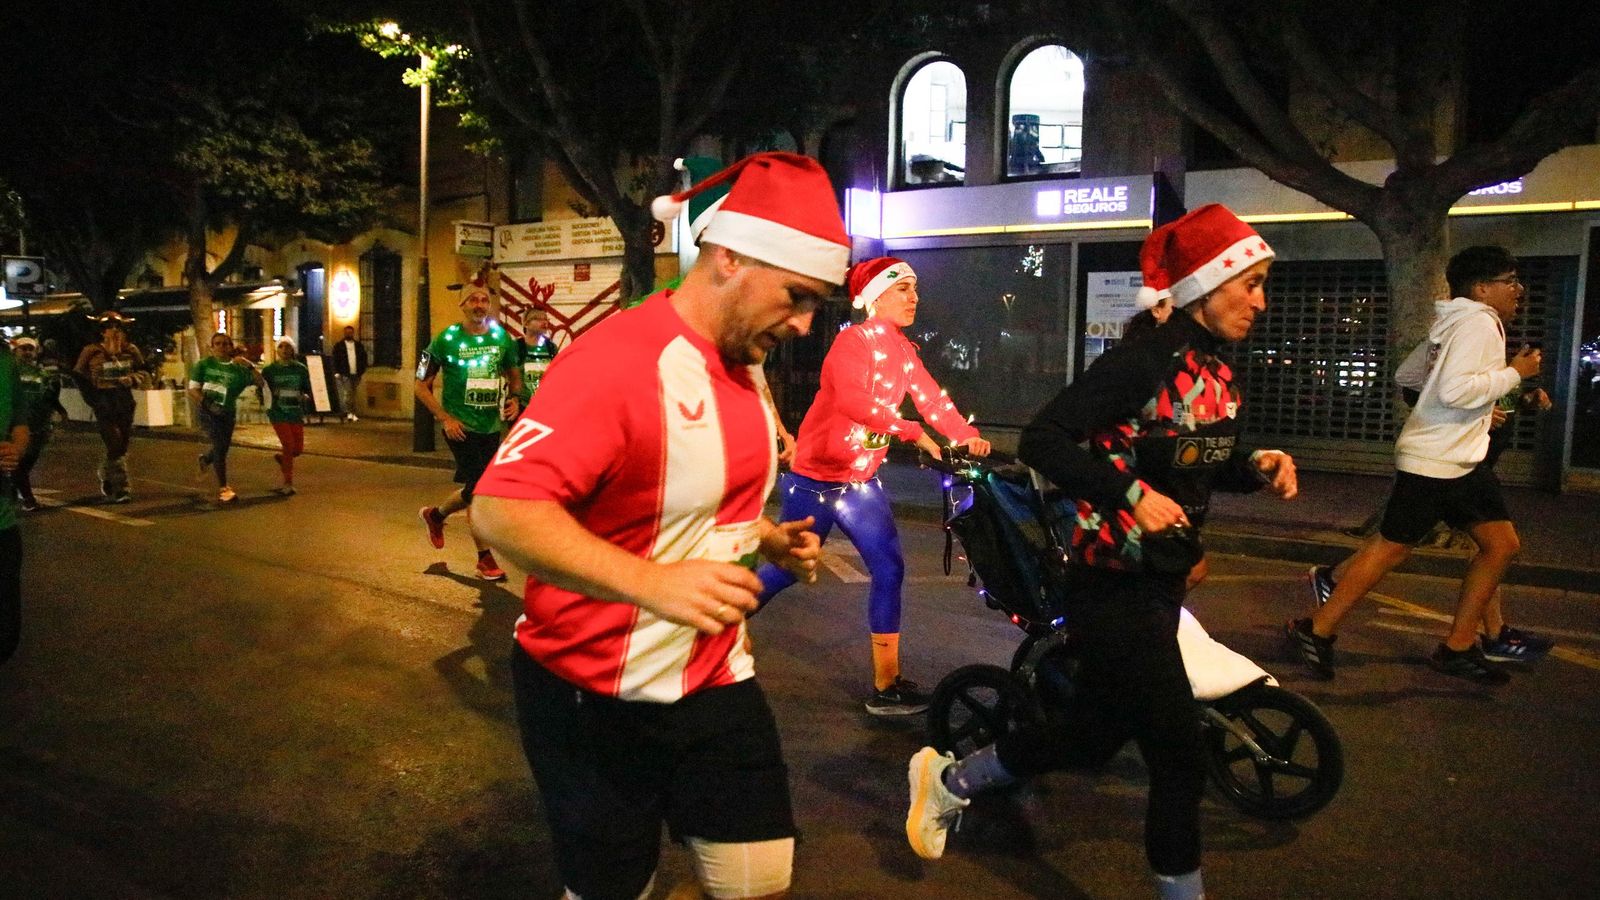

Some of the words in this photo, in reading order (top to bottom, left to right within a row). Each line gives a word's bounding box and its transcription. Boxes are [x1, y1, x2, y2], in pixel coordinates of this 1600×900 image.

[1064, 186, 1128, 203] REALE
[1064, 201, 1127, 214] SEGUROS
[6, 260, 41, 292] P
